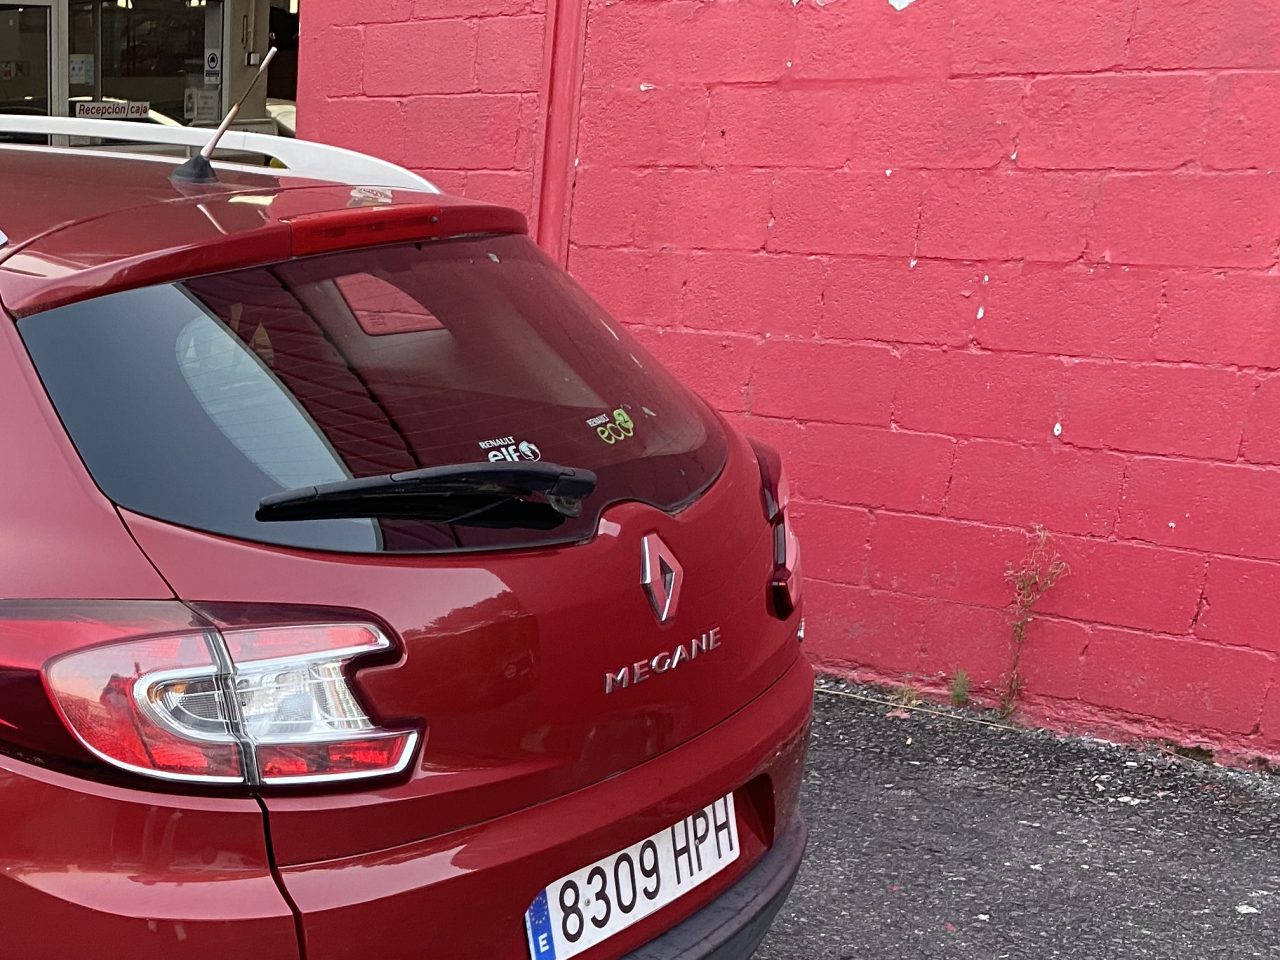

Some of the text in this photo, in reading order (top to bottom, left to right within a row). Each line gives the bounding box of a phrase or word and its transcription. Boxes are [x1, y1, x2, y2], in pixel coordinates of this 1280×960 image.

[478, 436, 516, 449] RENAULT
[488, 445, 520, 463] elf
[605, 626, 722, 694] MEGANE
[559, 795, 734, 943] 8309 HPH
[538, 932, 550, 953] E
